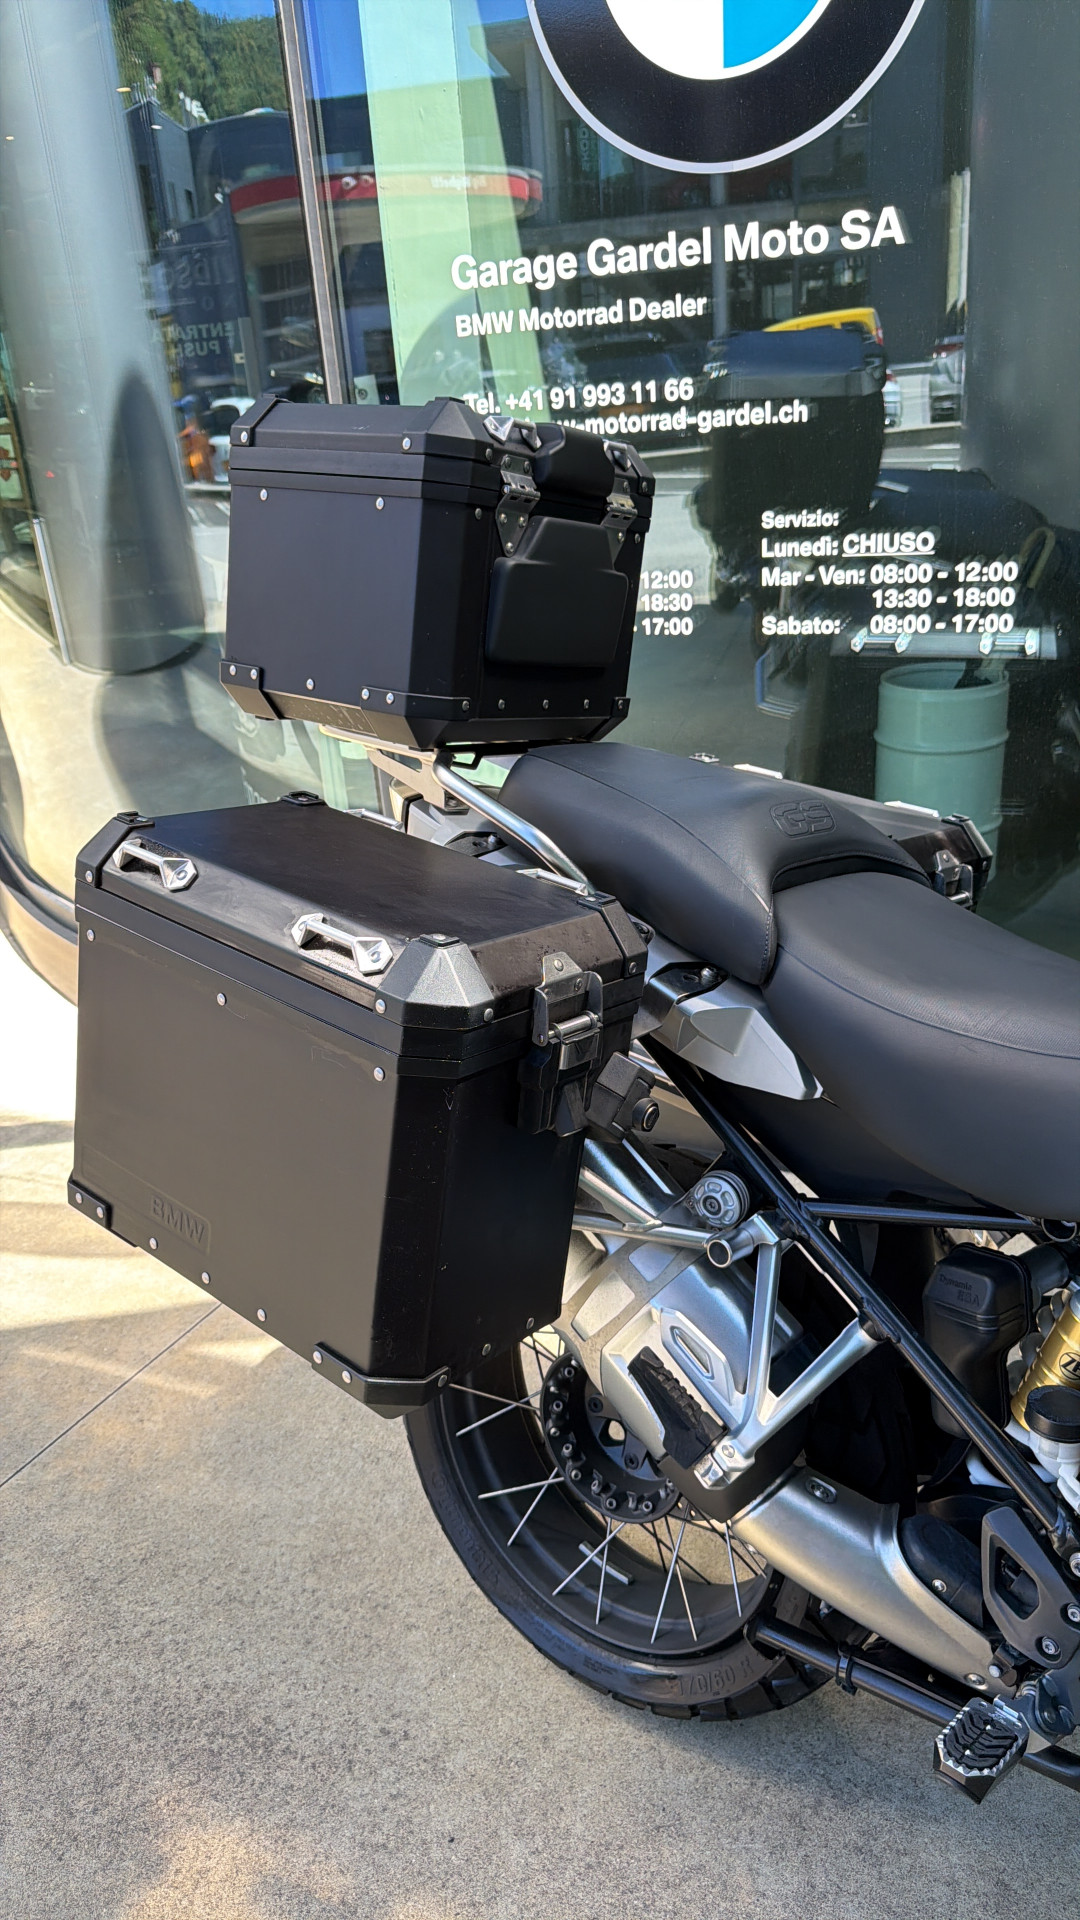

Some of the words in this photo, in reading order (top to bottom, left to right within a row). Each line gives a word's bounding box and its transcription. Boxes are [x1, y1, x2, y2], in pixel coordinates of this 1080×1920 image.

[450, 251, 578, 291] Garage
[587, 226, 712, 276] Gardel
[724, 220, 829, 262] Moto
[840, 205, 907, 250] SA
[455, 309, 514, 338] BMW
[518, 299, 624, 332] Motorrad
[629, 293, 707, 322] Dealer
[462, 391, 501, 416] Tel.
[505, 388, 544, 411] +41
[549, 386, 576, 410] 91
[582, 383, 626, 408] 993
[631, 381, 657, 404] 11
[664, 377, 694, 402] 66
[761, 509, 840, 529] Servizio:
[761, 535, 839, 558] Lunedì:
[842, 530, 936, 557] CHIUSO
[640, 569, 694, 590] 12:00
[761, 566, 802, 586] Mar
[818, 564, 866, 586] Ven:
[869, 562, 933, 585] 08:00
[954, 560, 1019, 583] 12:00
[640, 592, 693, 612] 18:30
[872, 587, 932, 609] 13:30
[953, 586, 1016, 607] 18:00
[641, 616, 694, 636] 17:00
[761, 615, 841, 635] Sabato:
[869, 613, 932, 634] 08:00
[952, 612, 1014, 633] 17:00
[769, 800, 835, 837] GS
[152, 1197, 206, 1244] BMW
